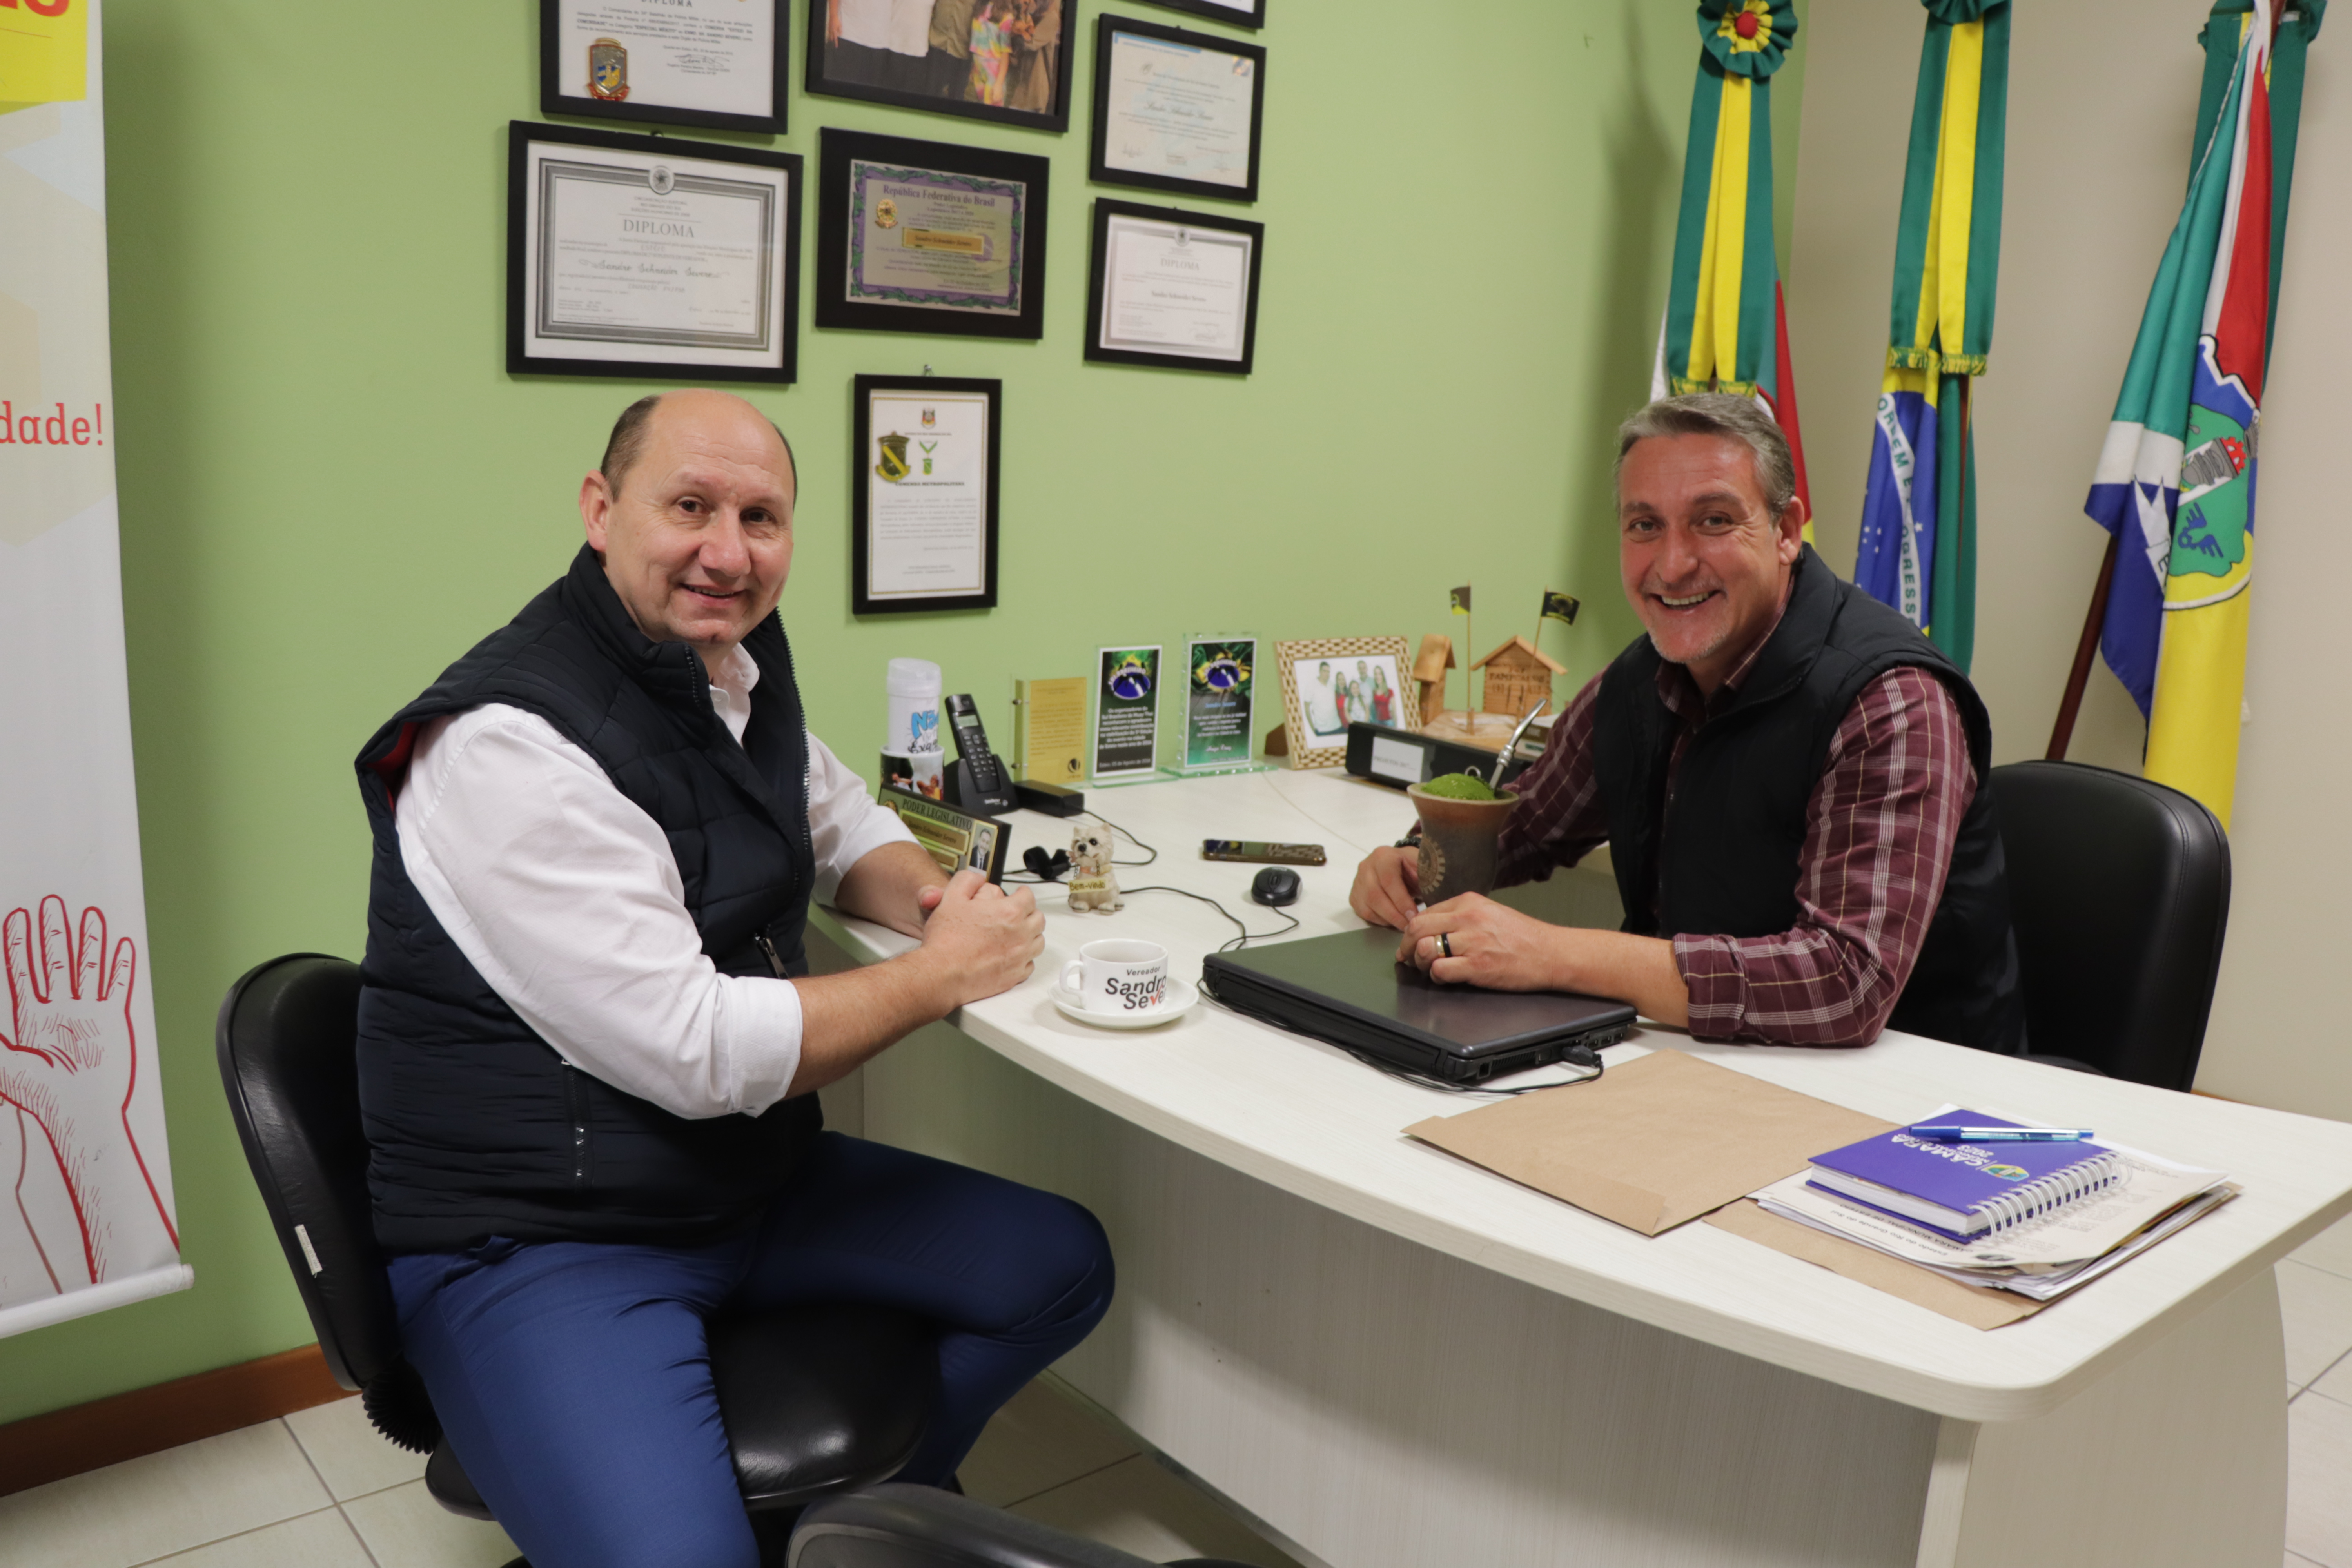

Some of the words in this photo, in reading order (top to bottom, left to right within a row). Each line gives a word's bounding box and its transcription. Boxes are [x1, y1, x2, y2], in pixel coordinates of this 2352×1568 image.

[883, 184, 920, 198] República
[923, 189, 962, 203] Federativa
[963, 195, 972, 204] do
[974, 196, 995, 207] Brasil
[624, 219, 695, 238] DIPLOMA
[1160, 257, 1200, 271] DIPLOMA
[903, 798, 926, 815] PODER
[927, 805, 972, 830] LEGISLATIVO
[1126, 966, 1161, 976] Vereador
[1105, 975, 1167, 996] Sandro
[1891, 1135, 1983, 1166] CÂMARA
[1956, 1145, 1994, 1158] 2023
[1839, 1203, 1872, 1217] ESTEIO
[1858, 1220, 1889, 1234] Grande
[1891, 1220, 1933, 1240] MUNICIPAL
[1890, 1232, 1905, 1241] Rio
[1918, 1242, 1949, 1256] Estado
